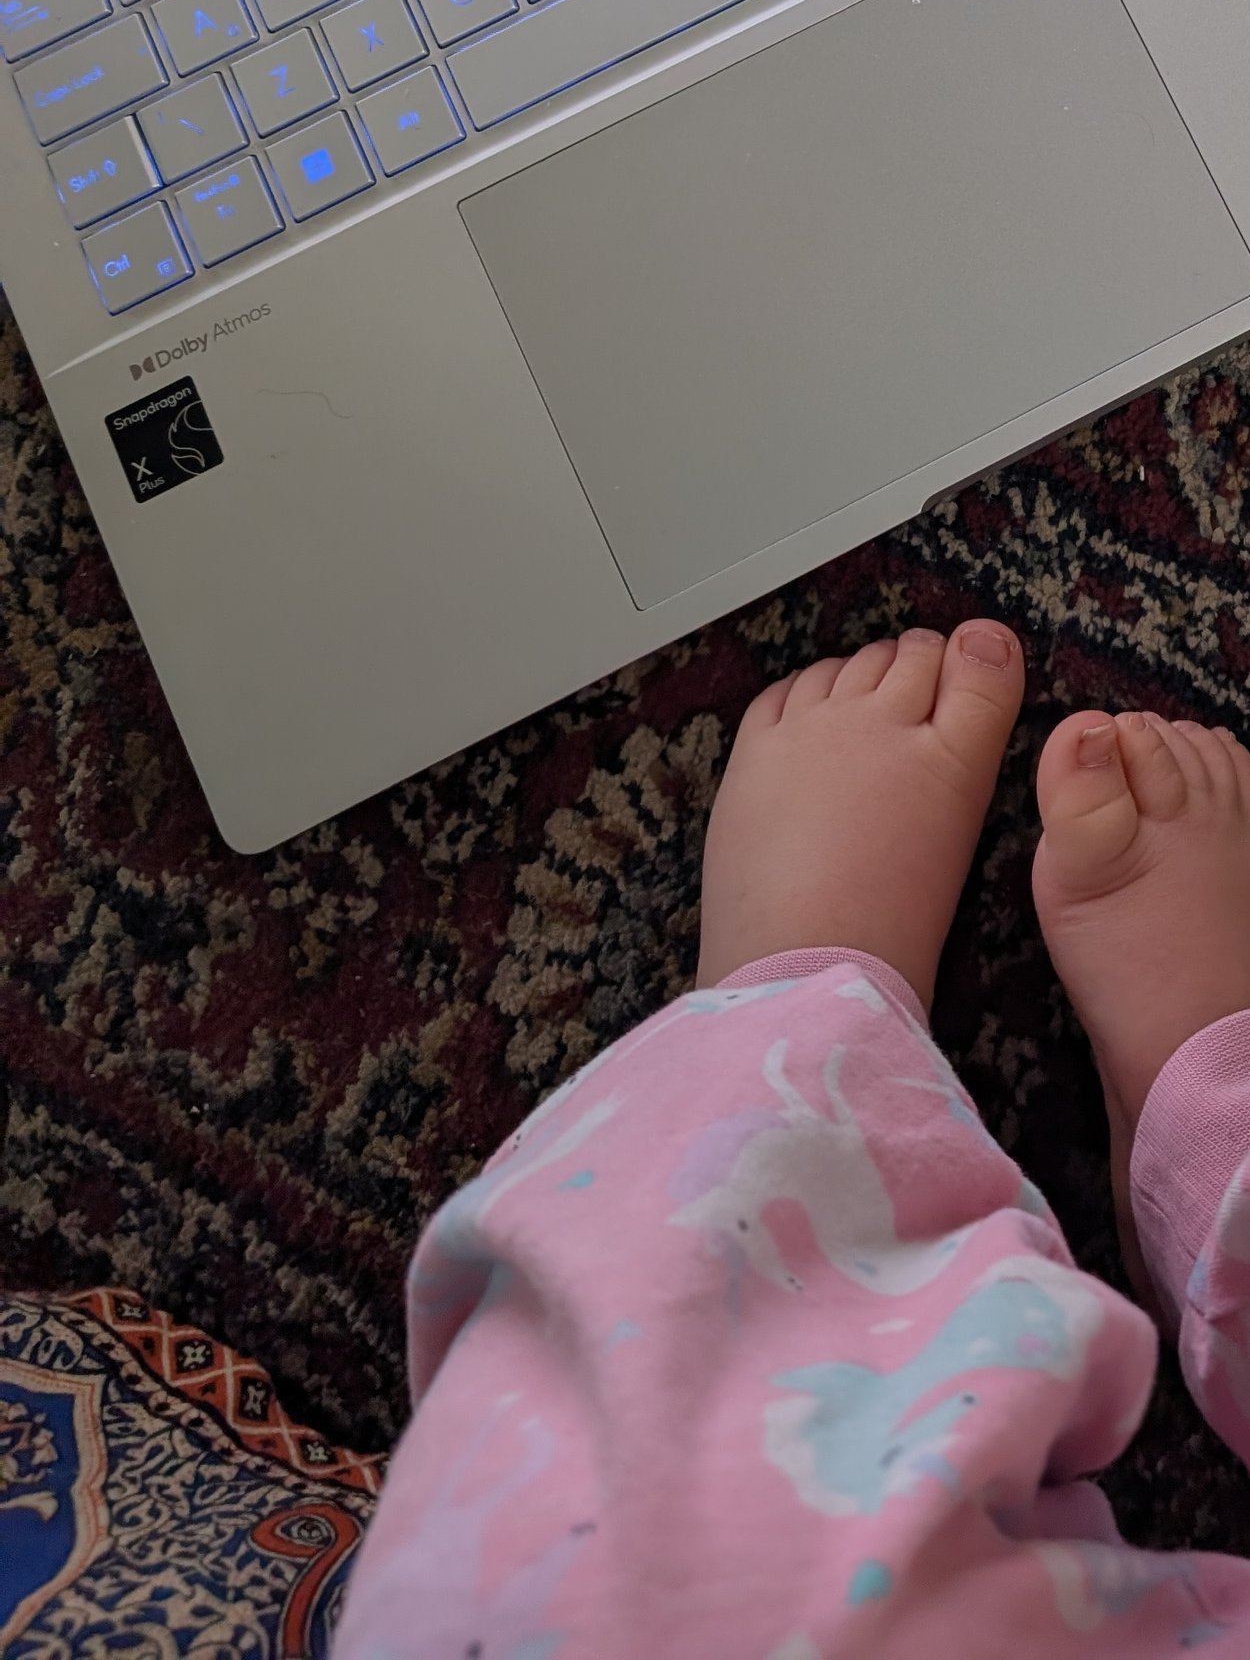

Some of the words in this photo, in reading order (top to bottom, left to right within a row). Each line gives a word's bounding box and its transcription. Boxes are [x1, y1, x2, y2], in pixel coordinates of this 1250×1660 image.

[194, 8, 218, 37] A
[357, 20, 385, 53] X
[267, 63, 297, 98] Z
[155, 332, 209, 370] Dolby
[213, 301, 272, 341] Atmos
[113, 385, 192, 431] Snapdragon
[130, 455, 155, 482] X
[138, 474, 166, 495] Plus
